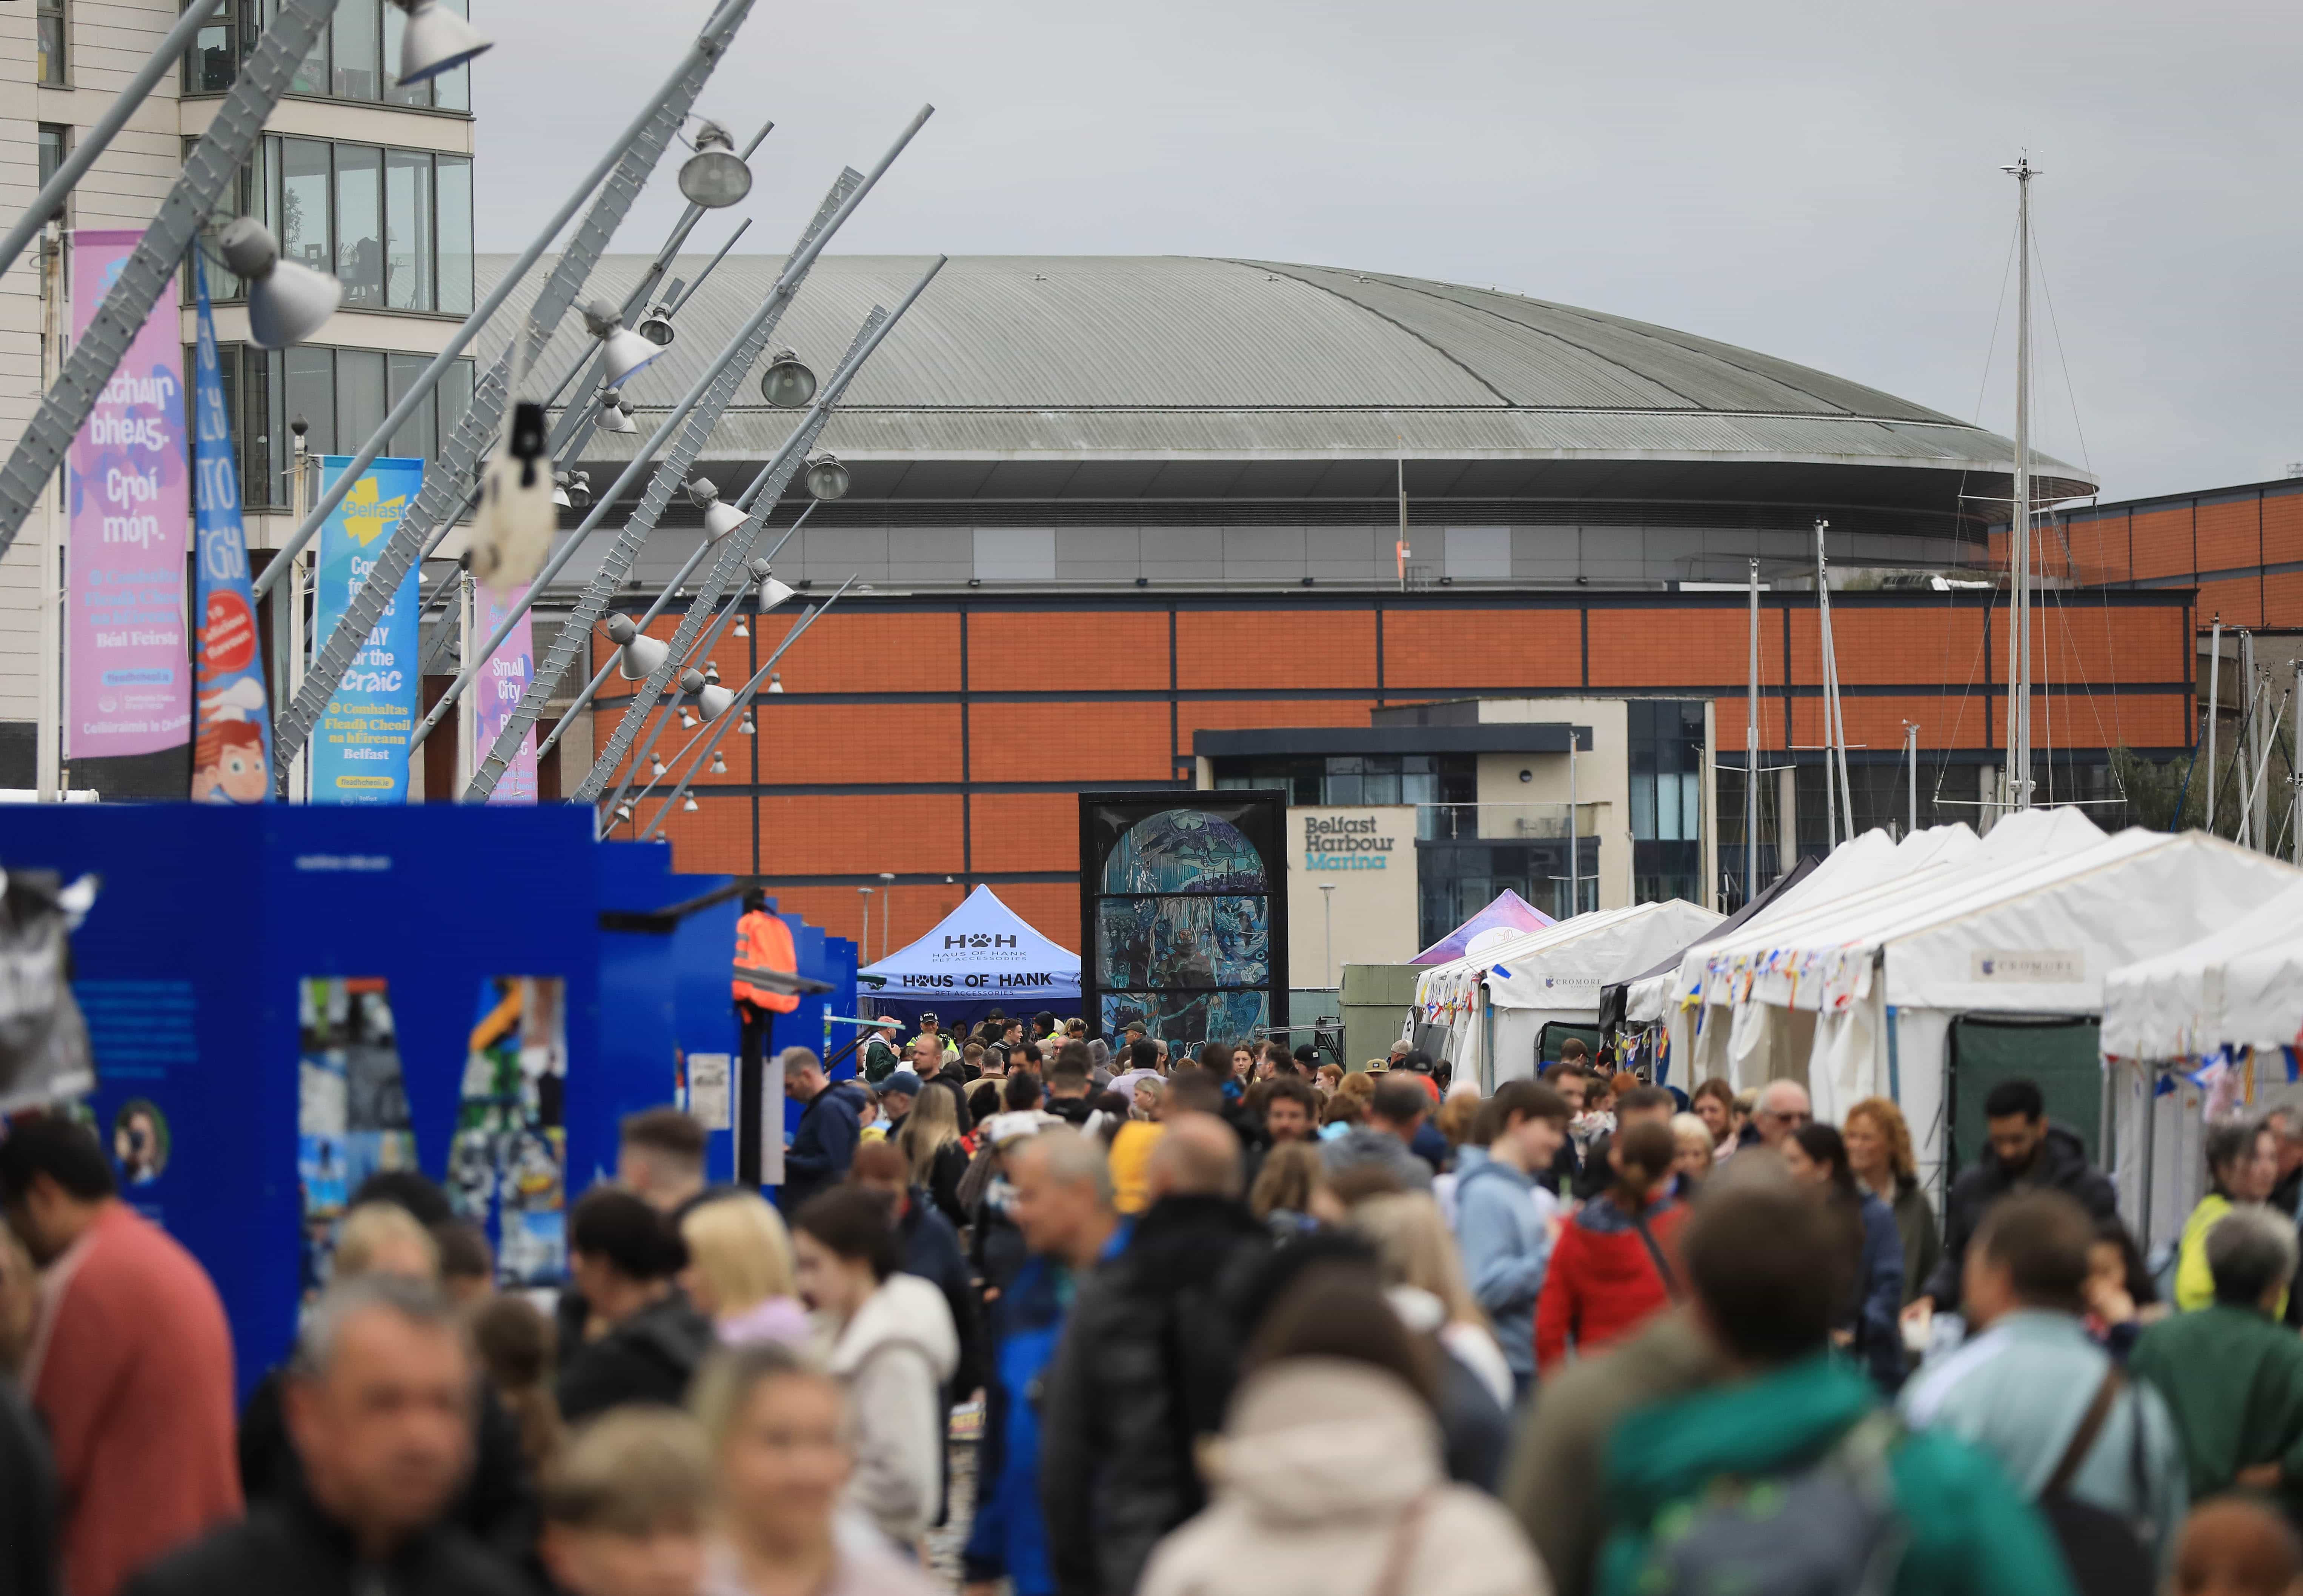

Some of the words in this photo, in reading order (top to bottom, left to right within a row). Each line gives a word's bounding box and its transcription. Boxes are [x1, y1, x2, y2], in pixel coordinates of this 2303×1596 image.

[346, 501, 406, 518] Belfast
[96, 631, 128, 648] Béal
[352, 652, 368, 665] or
[369, 649, 395, 666] the
[498, 680, 521, 704] City
[343, 703, 408, 715] Comhaltas
[324, 718, 367, 729] Fleadh
[370, 719, 411, 730] Cheoil
[329, 735, 344, 743] na
[344, 748, 389, 760] Belfast
[1305, 816, 1377, 833] Belfast
[1305, 834, 1394, 852] Harbour
[1305, 852, 1387, 871] Marina
[965, 974, 989, 987] OF
[999, 973, 1053, 987] HANK
